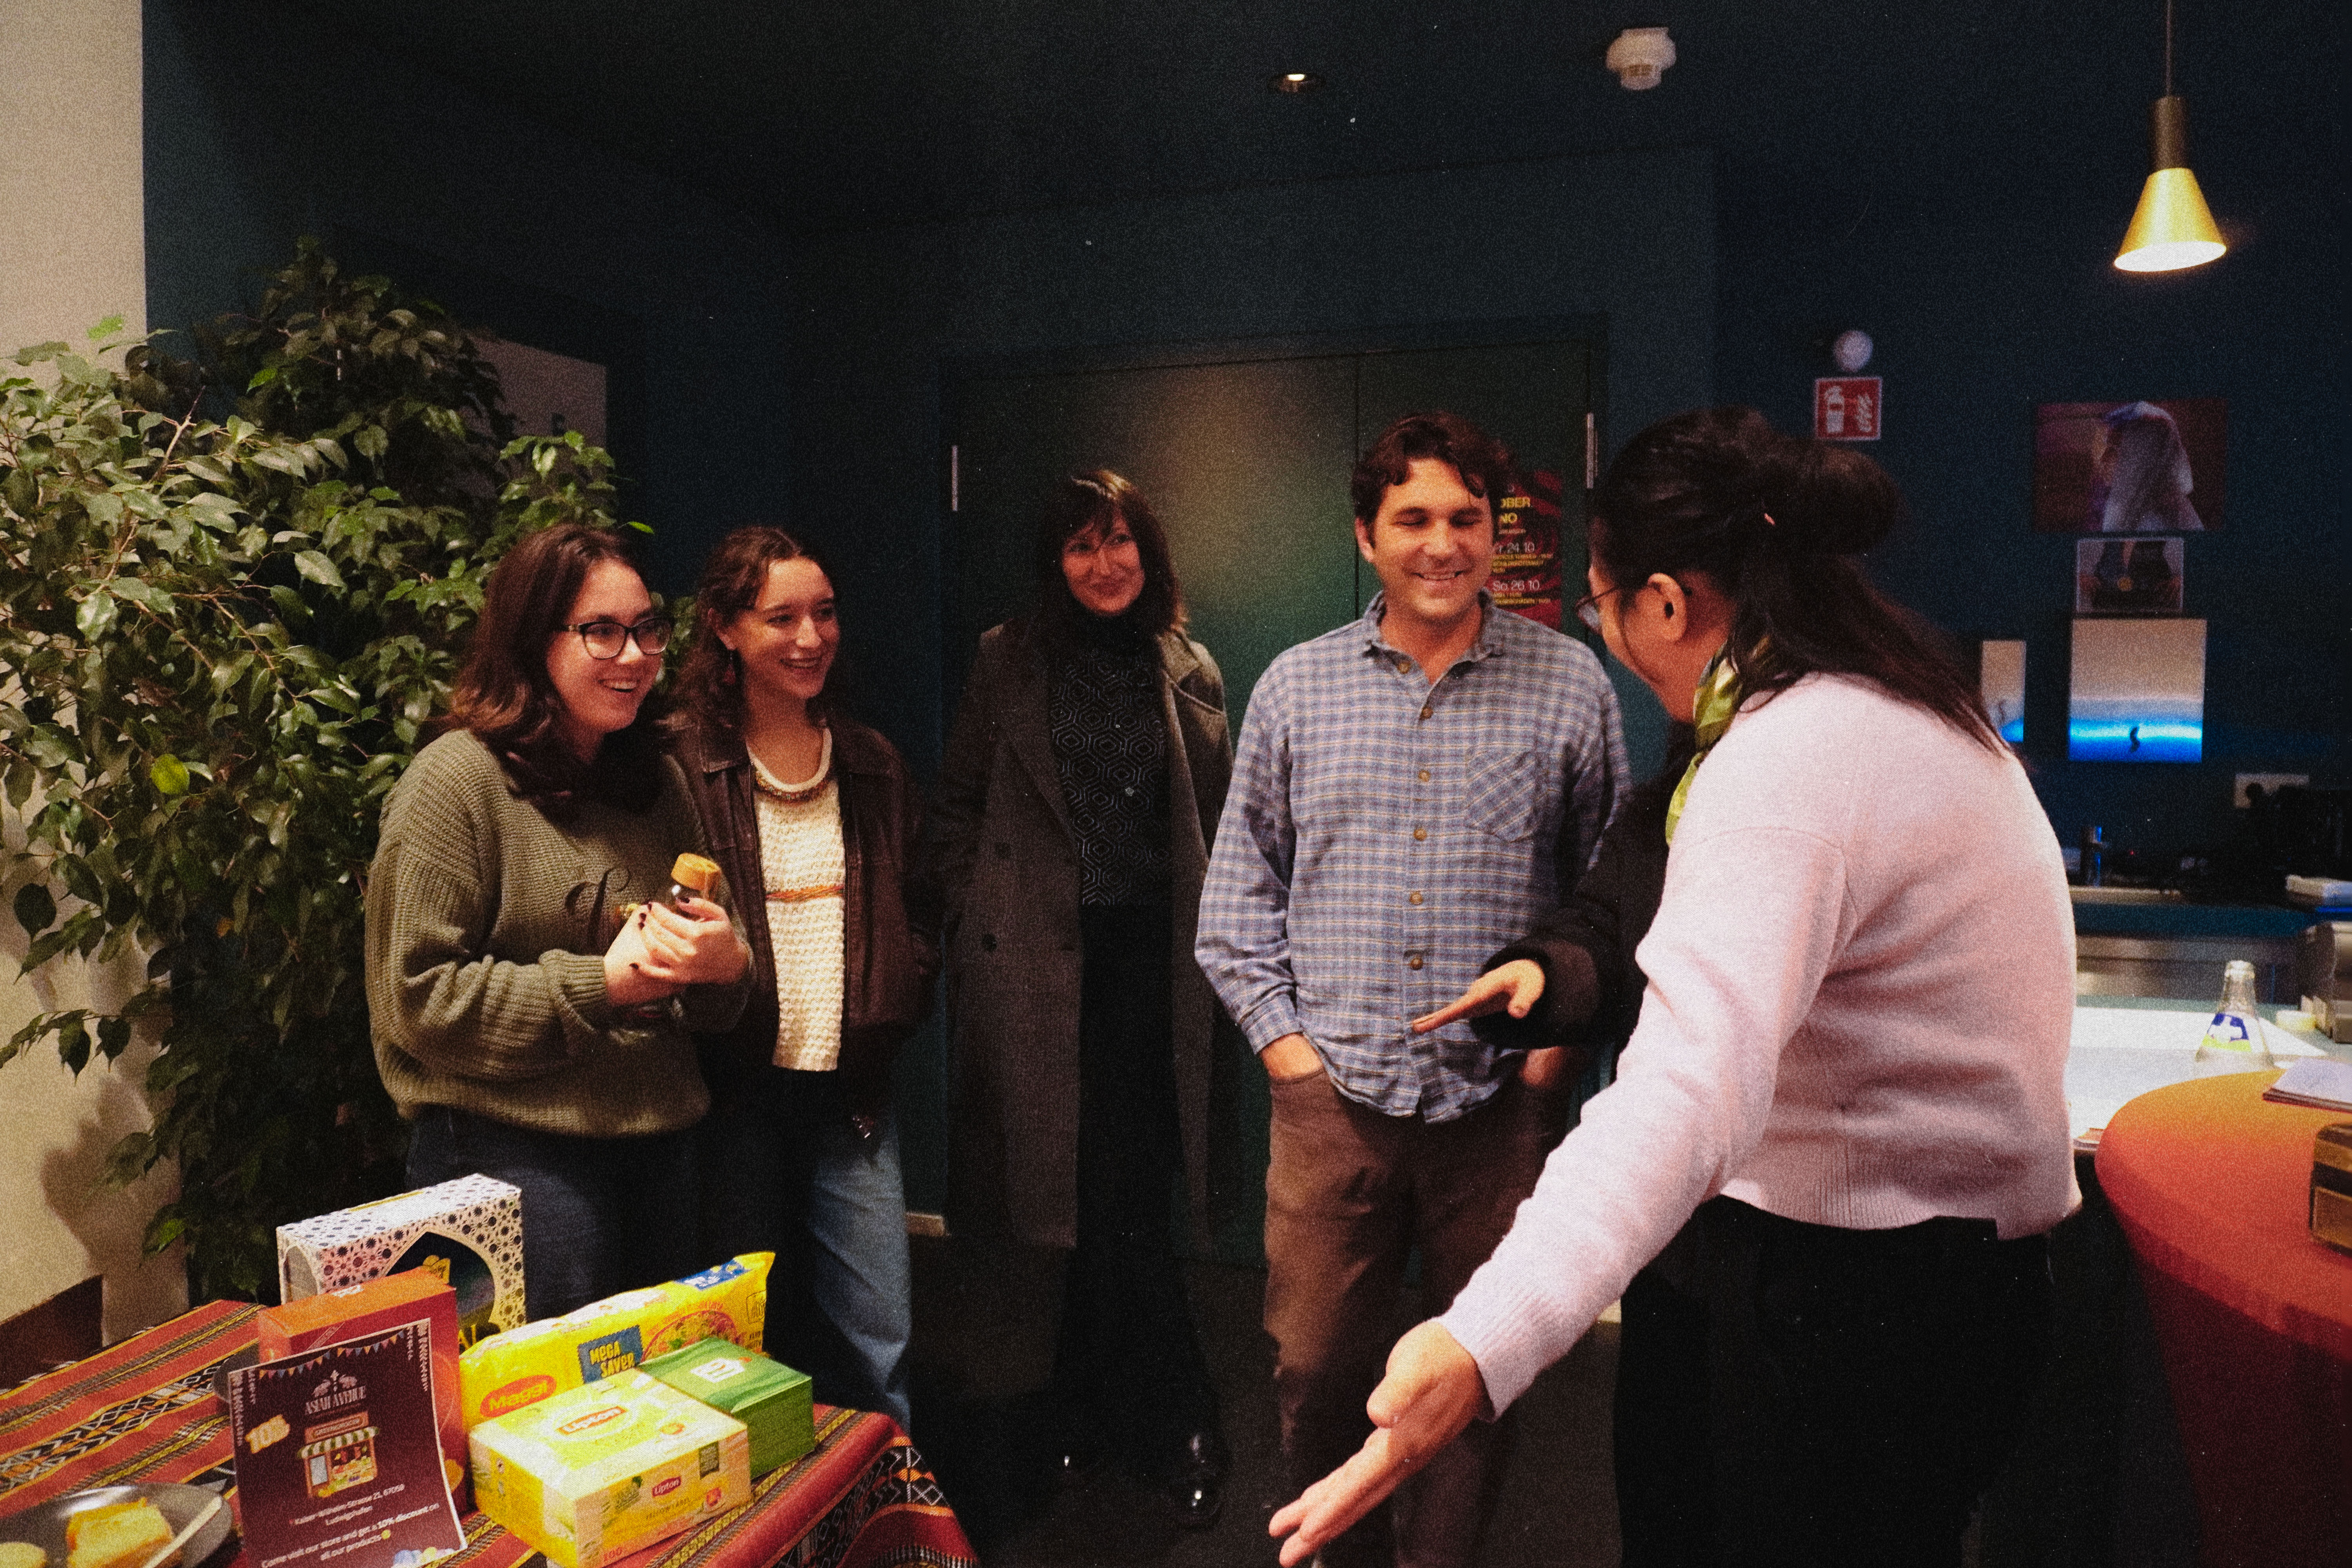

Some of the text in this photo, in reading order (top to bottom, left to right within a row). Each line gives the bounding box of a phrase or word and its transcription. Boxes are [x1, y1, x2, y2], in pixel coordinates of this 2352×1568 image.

[488, 1380, 548, 1412] Maggi
[561, 1408, 622, 1433] Lipton
[654, 1478, 681, 1495] Lipton
[261, 1555, 287, 1568] Come
[287, 1548, 305, 1560] visit
[305, 1544, 319, 1553] our
[319, 1537, 342, 1548] store
[342, 1530, 358, 1541] and
[358, 1526, 371, 1538] get
[377, 1517, 395, 1528] 10%
[395, 1506, 429, 1523] discount
[331, 1547, 345, 1557] our
[345, 1535, 382, 1553] products
[603, 1547, 623, 1562] 100
